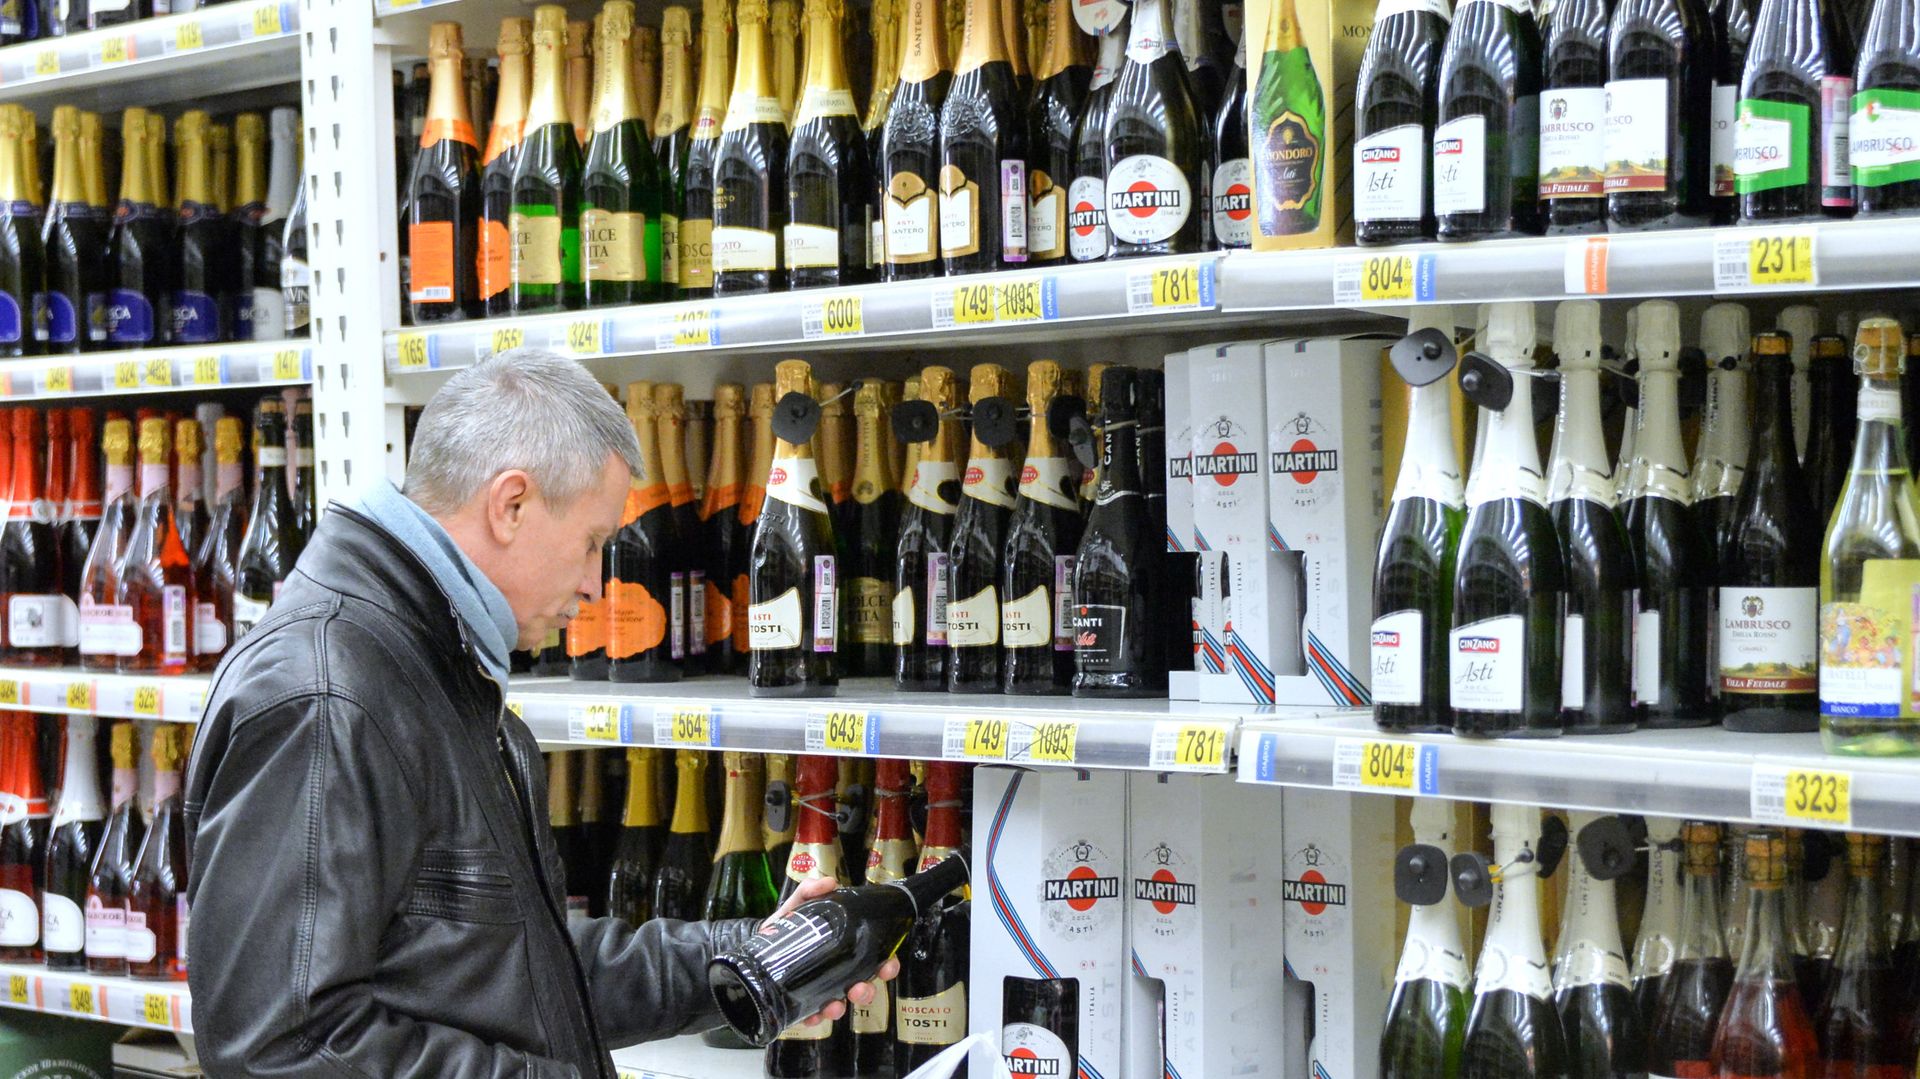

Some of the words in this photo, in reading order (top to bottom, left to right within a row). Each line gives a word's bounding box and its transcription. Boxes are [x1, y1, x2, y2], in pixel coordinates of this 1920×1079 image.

[914, 2, 922, 57] SANTERO
[1362, 149, 1397, 162] CINZANO
[1362, 169, 1397, 192] Asti
[1552, 183, 1589, 193] FEUDALE
[1112, 191, 1179, 209] MARTINI
[1216, 194, 1250, 213] MART
[1070, 211, 1106, 227] ARTIN
[1757, 236, 1797, 275] 231
[1368, 255, 1403, 292] 804
[1160, 267, 1190, 304] 781
[960, 285, 988, 317] 749
[1003, 281, 1034, 315] 1095
[827, 298, 853, 330] 600
[570, 321, 592, 348] 324
[403, 338, 424, 365] 165
[1104, 420, 1112, 466] CANI
[1197, 454, 1256, 475] MARTINI
[1273, 451, 1336, 473] MARTINI
[1072, 617, 1102, 627] CANTI
[1725, 618, 1791, 630] LAMBRUSCO
[1460, 638, 1496, 651] CINZANO
[1456, 659, 1496, 684] Asti
[1726, 678, 1744, 688] VILLA
[1746, 679, 1787, 689] FEUDALE
[678, 712, 702, 738] 564
[830, 713, 855, 743] 643
[973, 719, 1000, 749] 749
[1038, 723, 1067, 754] 1095
[1185, 731, 1215, 763] 781
[1261, 740, 1270, 777] СЛАДКОЕ
[1369, 743, 1405, 779] 804
[1795, 773, 1837, 814] 323
[792, 859, 816, 867] TOSTI
[1047, 878, 1117, 899] MARTINI
[1135, 880, 1195, 903] MARTINI
[1284, 882, 1344, 904] MARTINI
[1069, 926, 1093, 934] ASTI
[74, 989, 91, 1012] 349
[149, 996, 166, 1021] 551
[901, 1005, 951, 1014] MOSCATO
[905, 1018, 947, 1028] TOSTI
[1003, 1056, 1059, 1075] ARTINI
